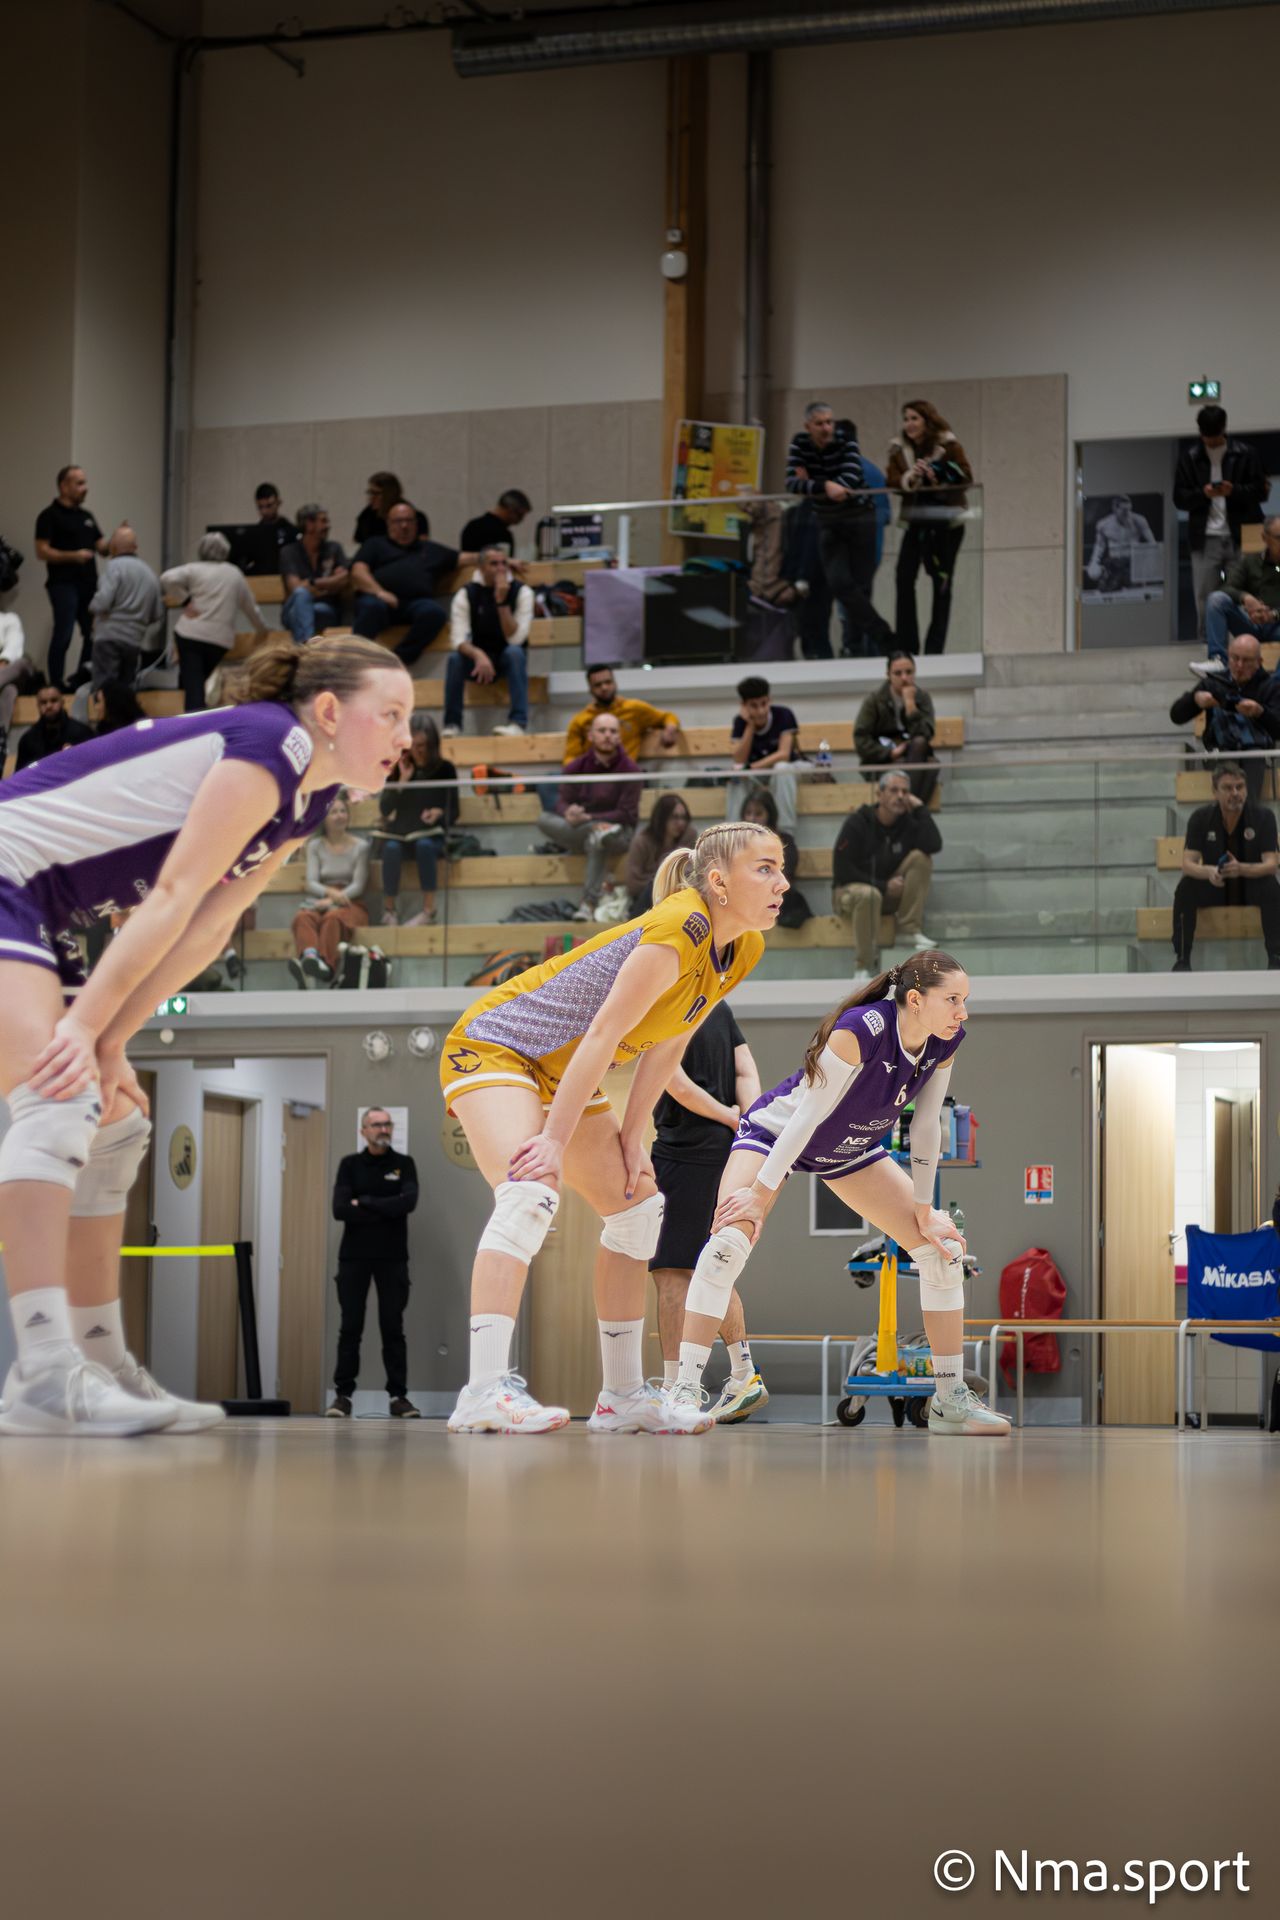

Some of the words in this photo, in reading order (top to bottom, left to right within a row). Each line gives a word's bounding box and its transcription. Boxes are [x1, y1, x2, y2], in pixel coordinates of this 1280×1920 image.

[684, 918, 705, 945] KING
[864, 1013, 881, 1035] KING
[893, 1083, 907, 1107] 6
[842, 1135, 872, 1146] NES
